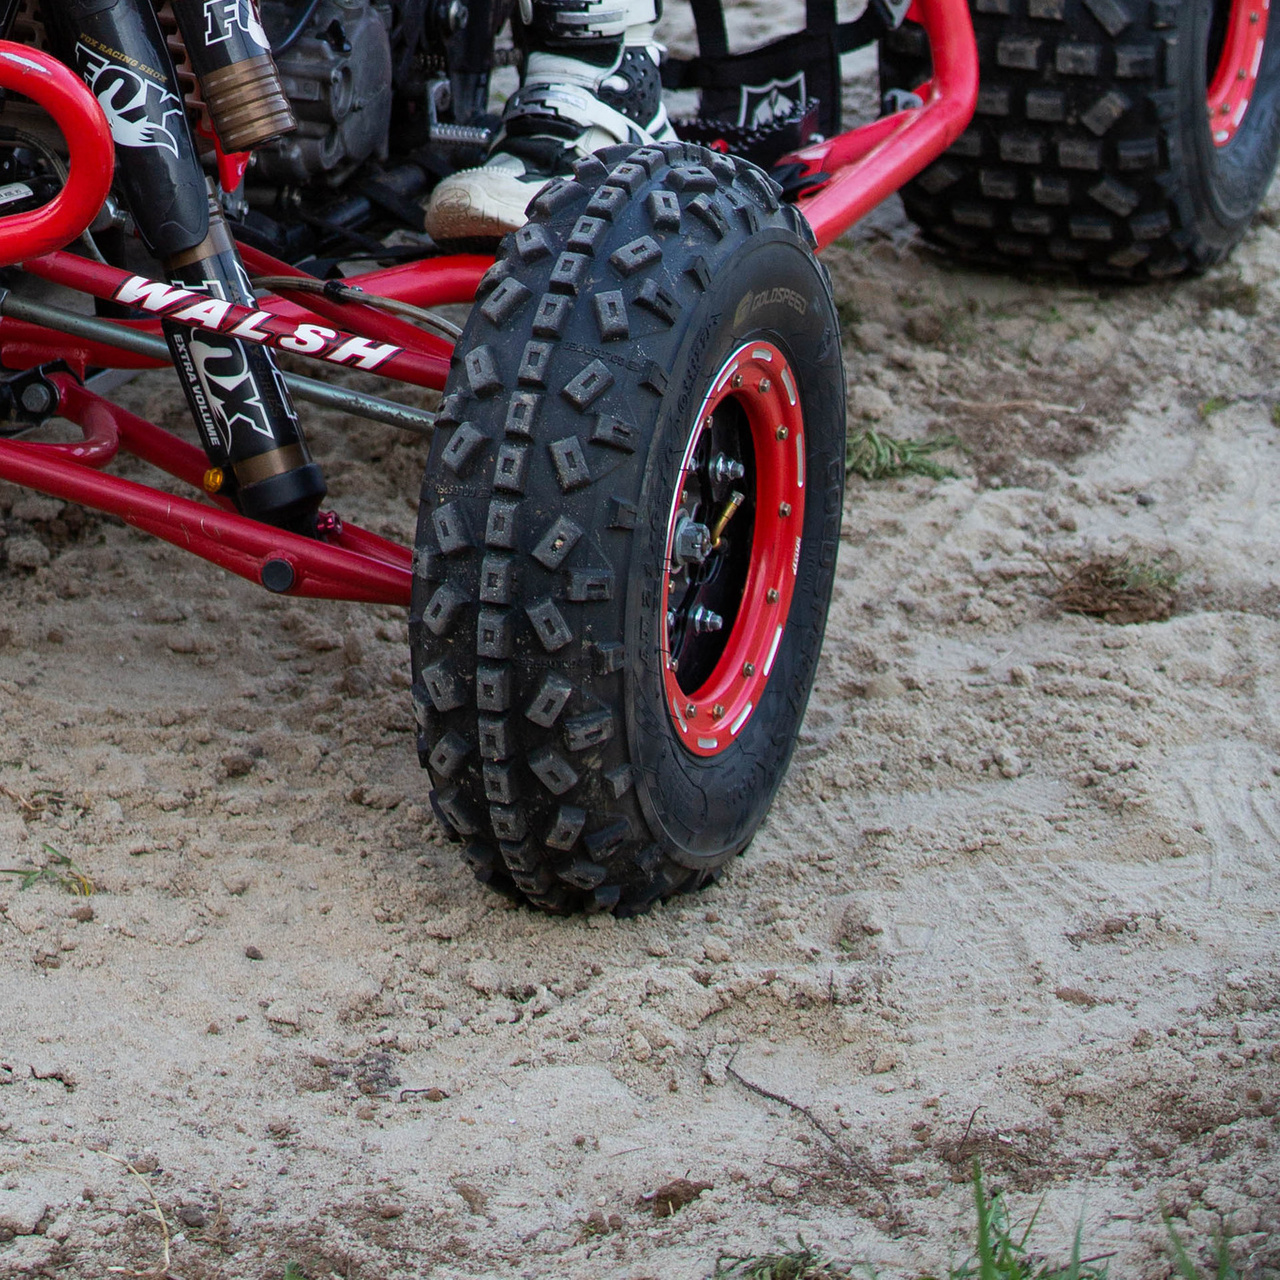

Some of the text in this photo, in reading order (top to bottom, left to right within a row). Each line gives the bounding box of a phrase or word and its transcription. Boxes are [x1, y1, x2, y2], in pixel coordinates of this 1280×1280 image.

[97, 43, 139, 67] RACING
[138, 63, 168, 83] SHOX
[115, 275, 404, 370] WALSH
[752, 287, 807, 316] GOLDSPEED
[172, 333, 221, 447] EXTRA VOLUME
